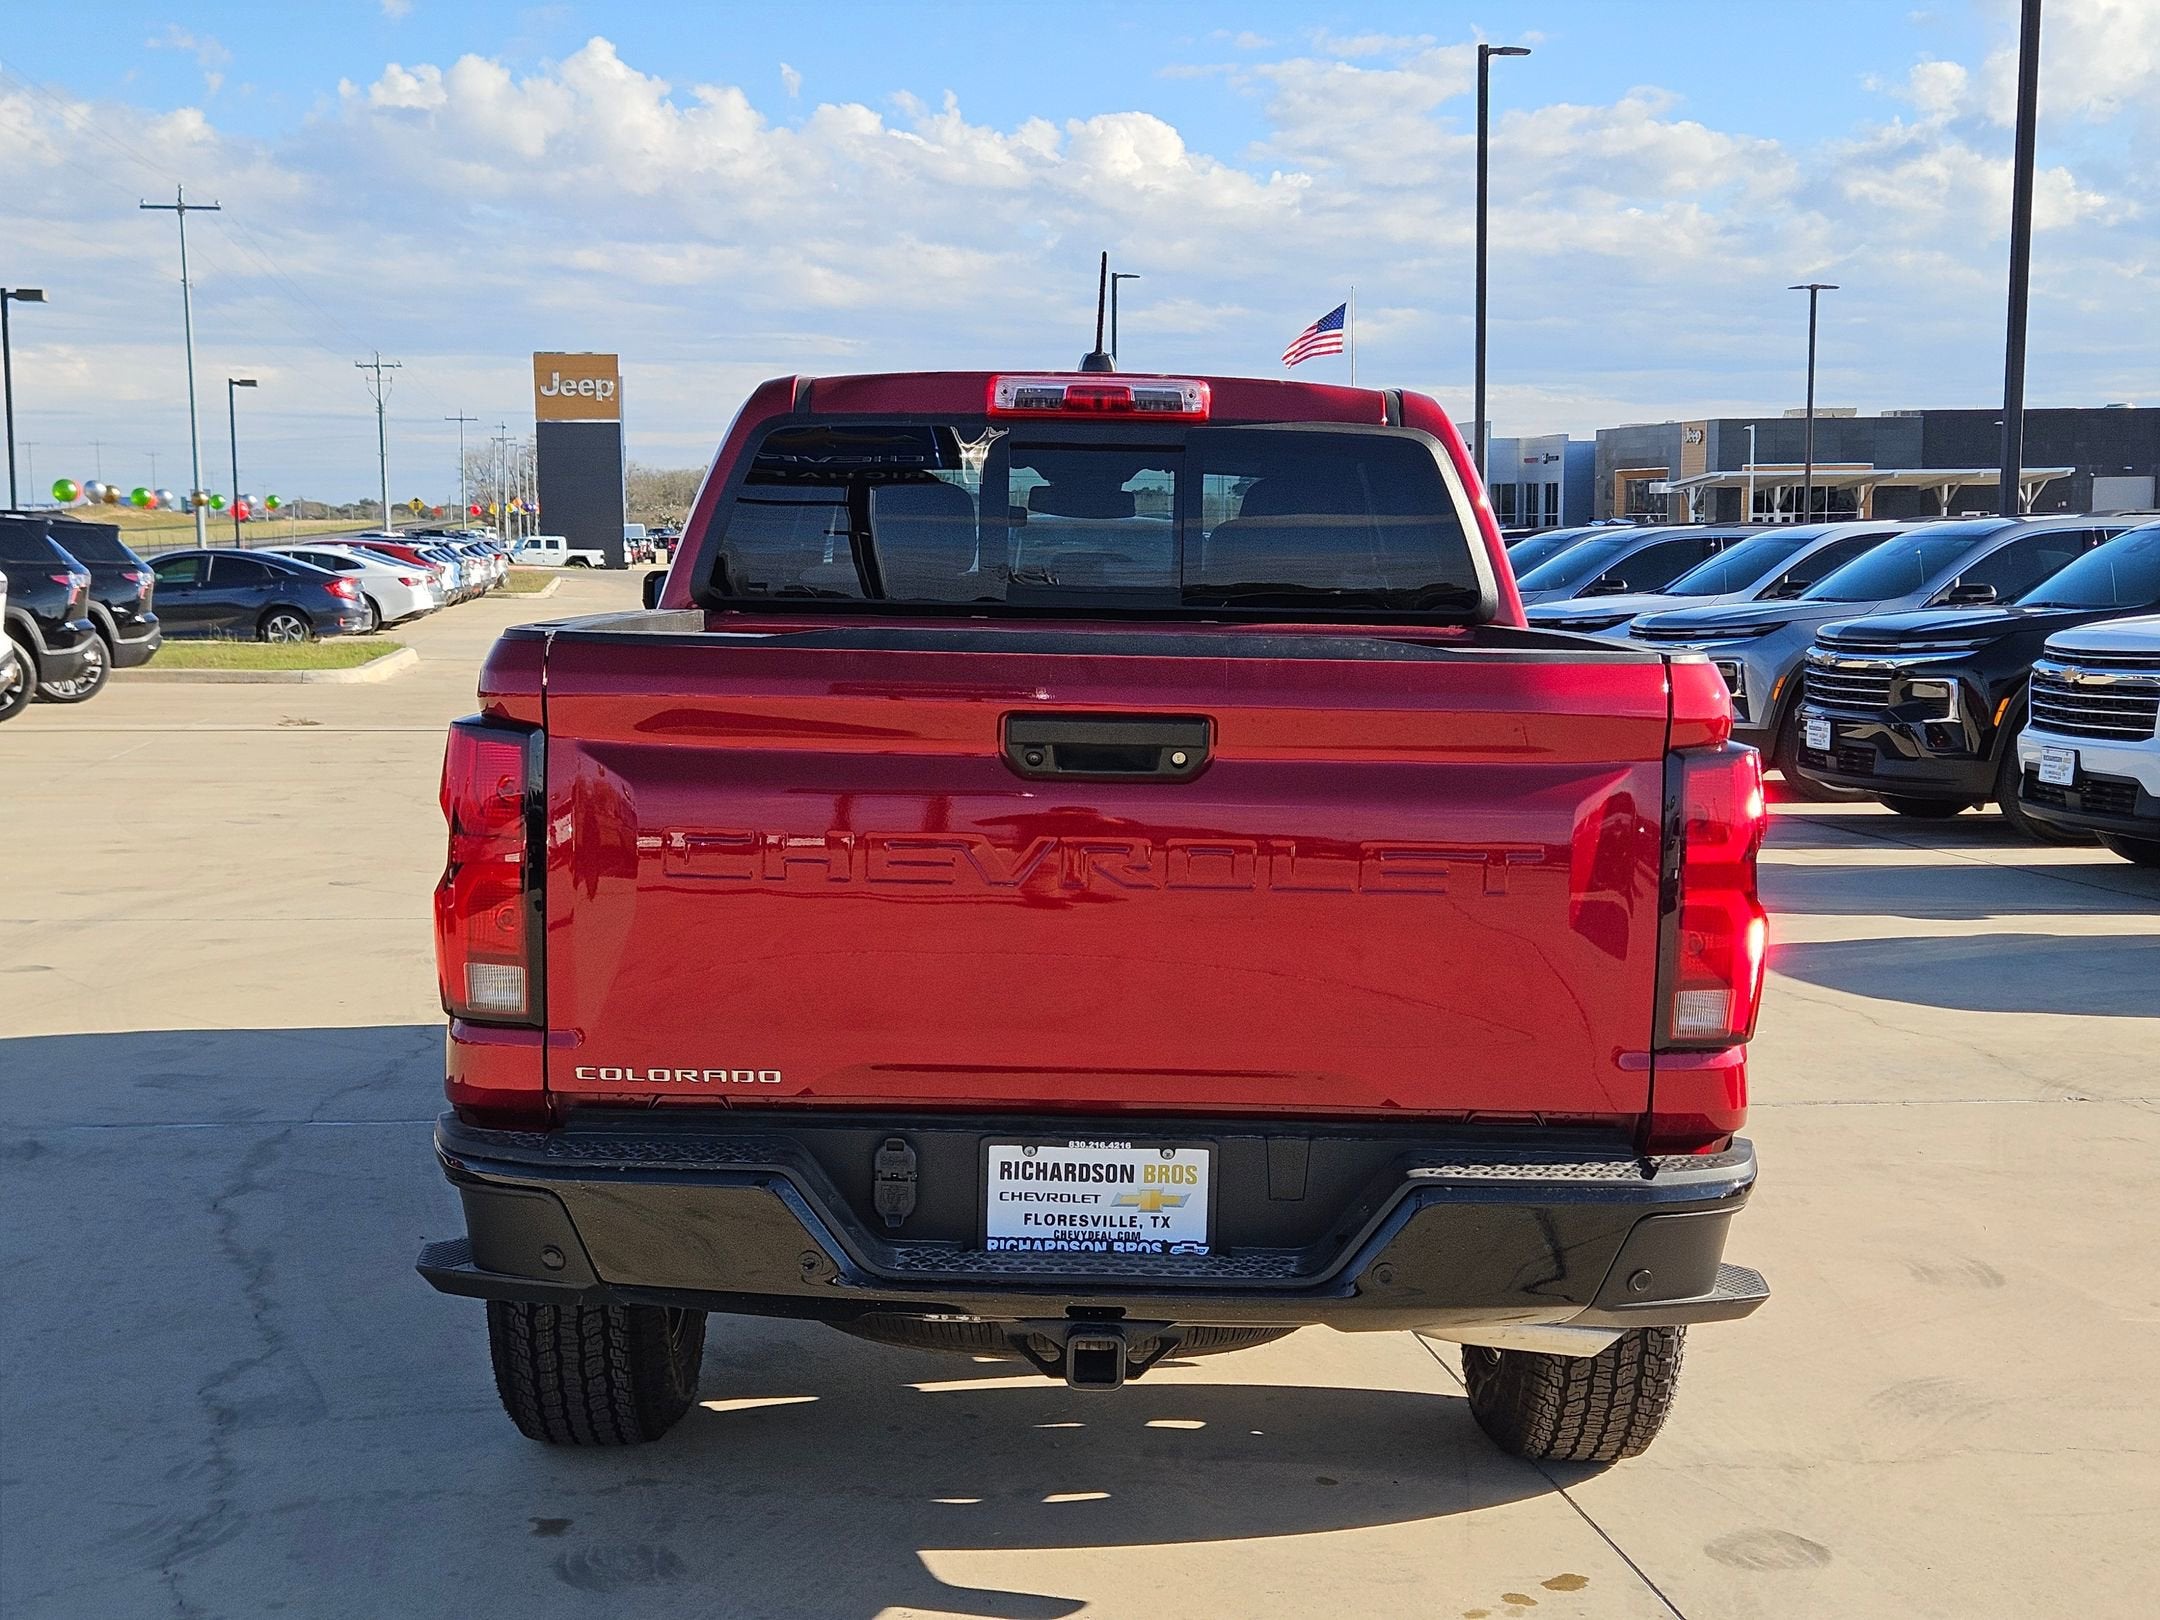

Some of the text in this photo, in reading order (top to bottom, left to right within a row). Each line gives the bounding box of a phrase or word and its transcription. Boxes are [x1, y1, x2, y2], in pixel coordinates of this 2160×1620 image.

[540, 371, 614, 402] Jeep
[663, 827, 1545, 897] CHEVROLET
[575, 1066, 782, 1083] COLORADO
[999, 1160, 1198, 1185] RICHARDSON BROS
[999, 1191, 1102, 1204] CHEVROLET
[1023, 1213, 1171, 1229] FLORESVILLE, TX
[1053, 1229, 1141, 1241] CHEVYDEAL.COM
